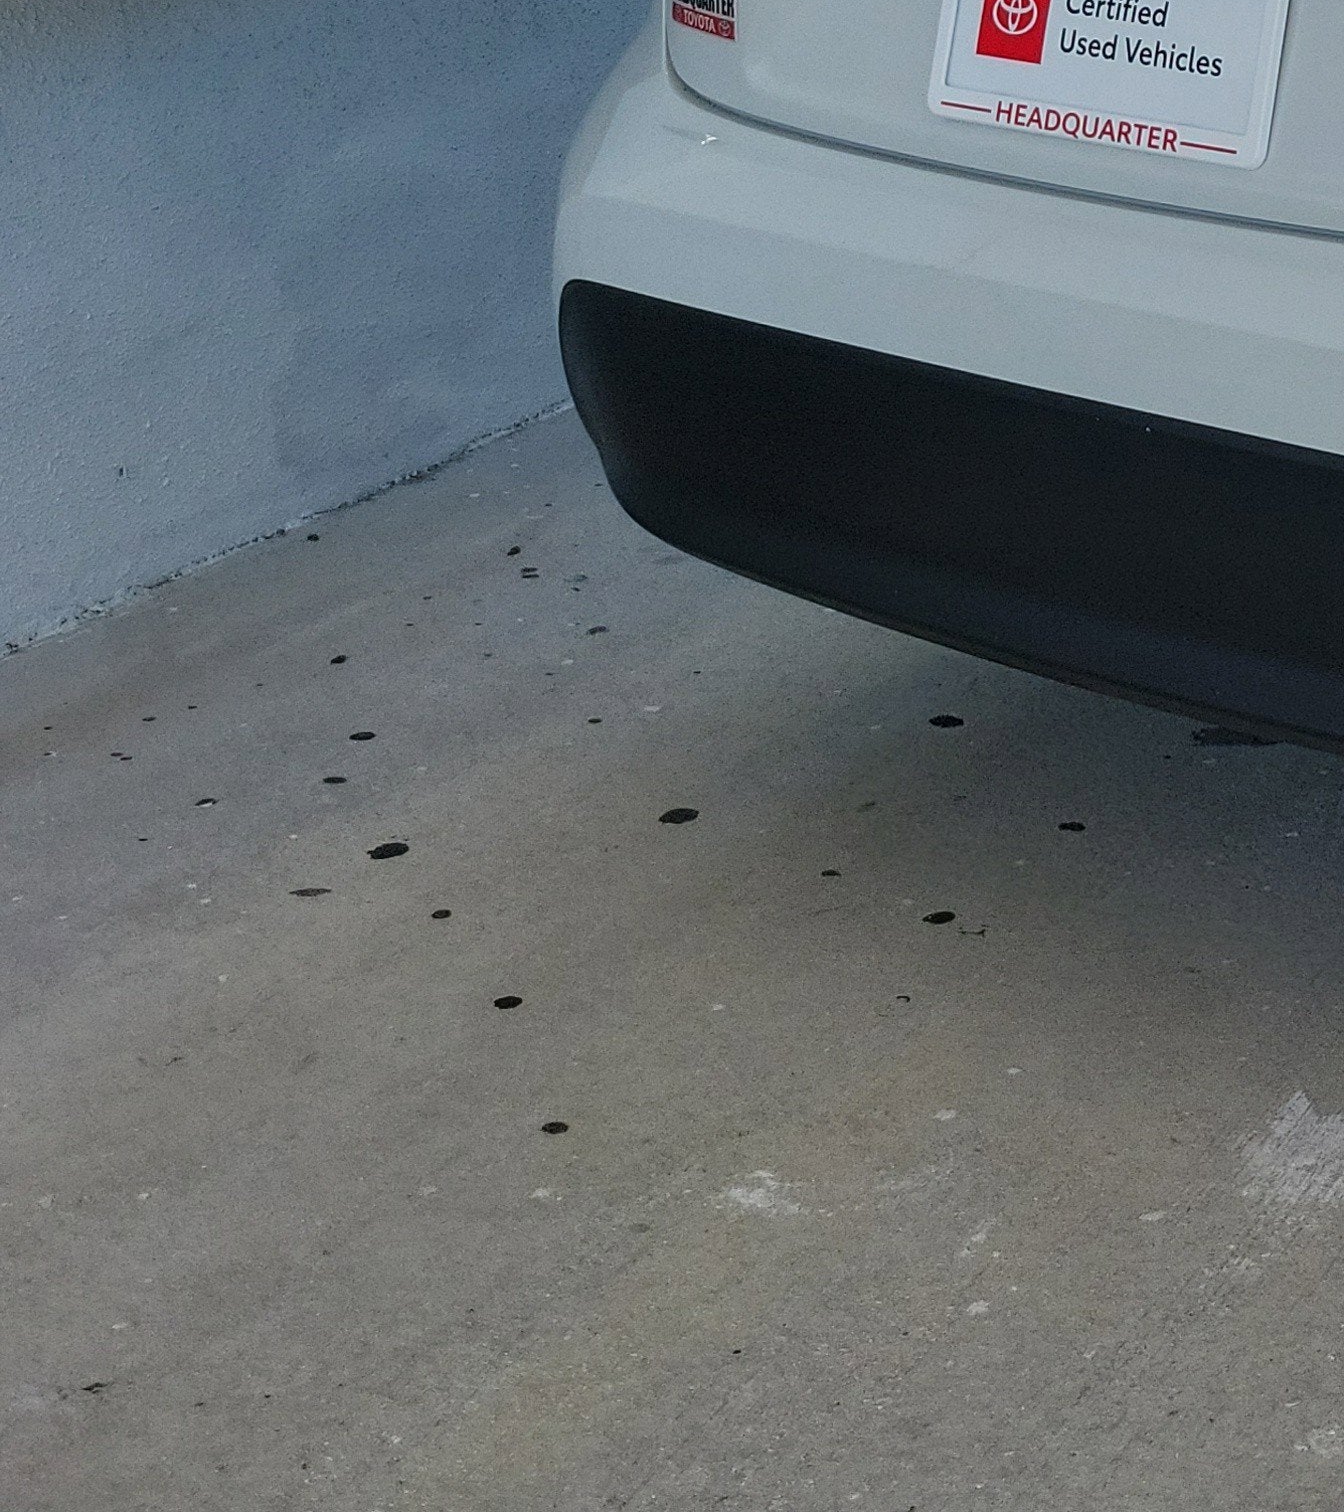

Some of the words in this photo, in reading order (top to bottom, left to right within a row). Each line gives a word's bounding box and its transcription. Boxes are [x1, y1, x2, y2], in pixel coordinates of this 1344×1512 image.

[683, 9, 716, 34] TOYOTA
[1060, 27, 1119, 60] Used
[1125, 37, 1223, 77] Vehicles
[995, 100, 1179, 153] HEADQUARTER
